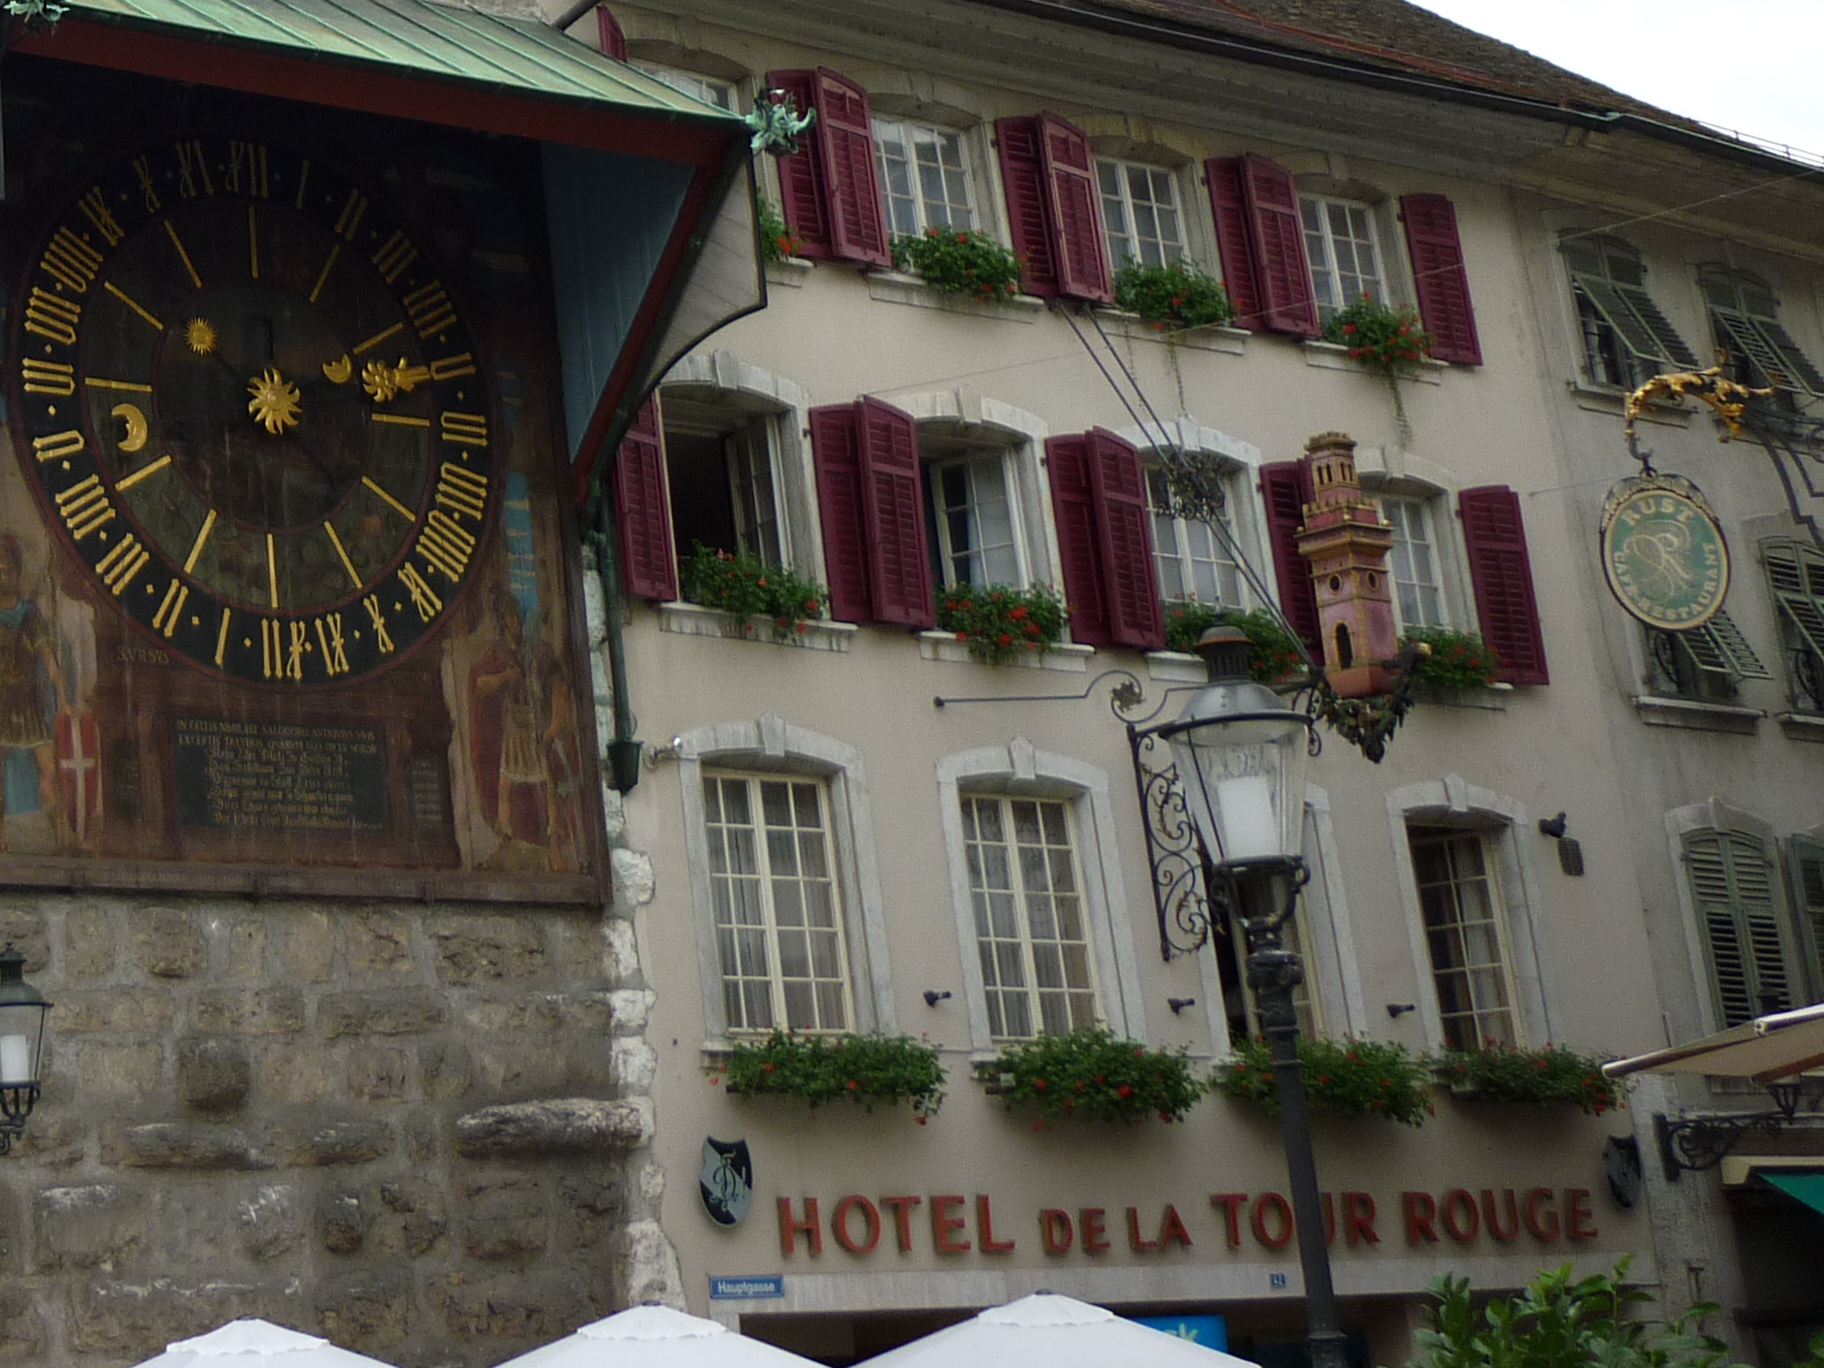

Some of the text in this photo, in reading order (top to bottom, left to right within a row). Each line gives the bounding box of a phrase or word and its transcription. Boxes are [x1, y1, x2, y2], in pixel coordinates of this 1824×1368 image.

[1622, 498, 1694, 525] RUST
[778, 1194, 1015, 1255] HOTEL
[1040, 1208, 1110, 1252] DE
[1126, 1204, 1193, 1249] LA
[1402, 1187, 1598, 1244] ROUGE
[718, 1280, 776, 1295] Hauptgasse
